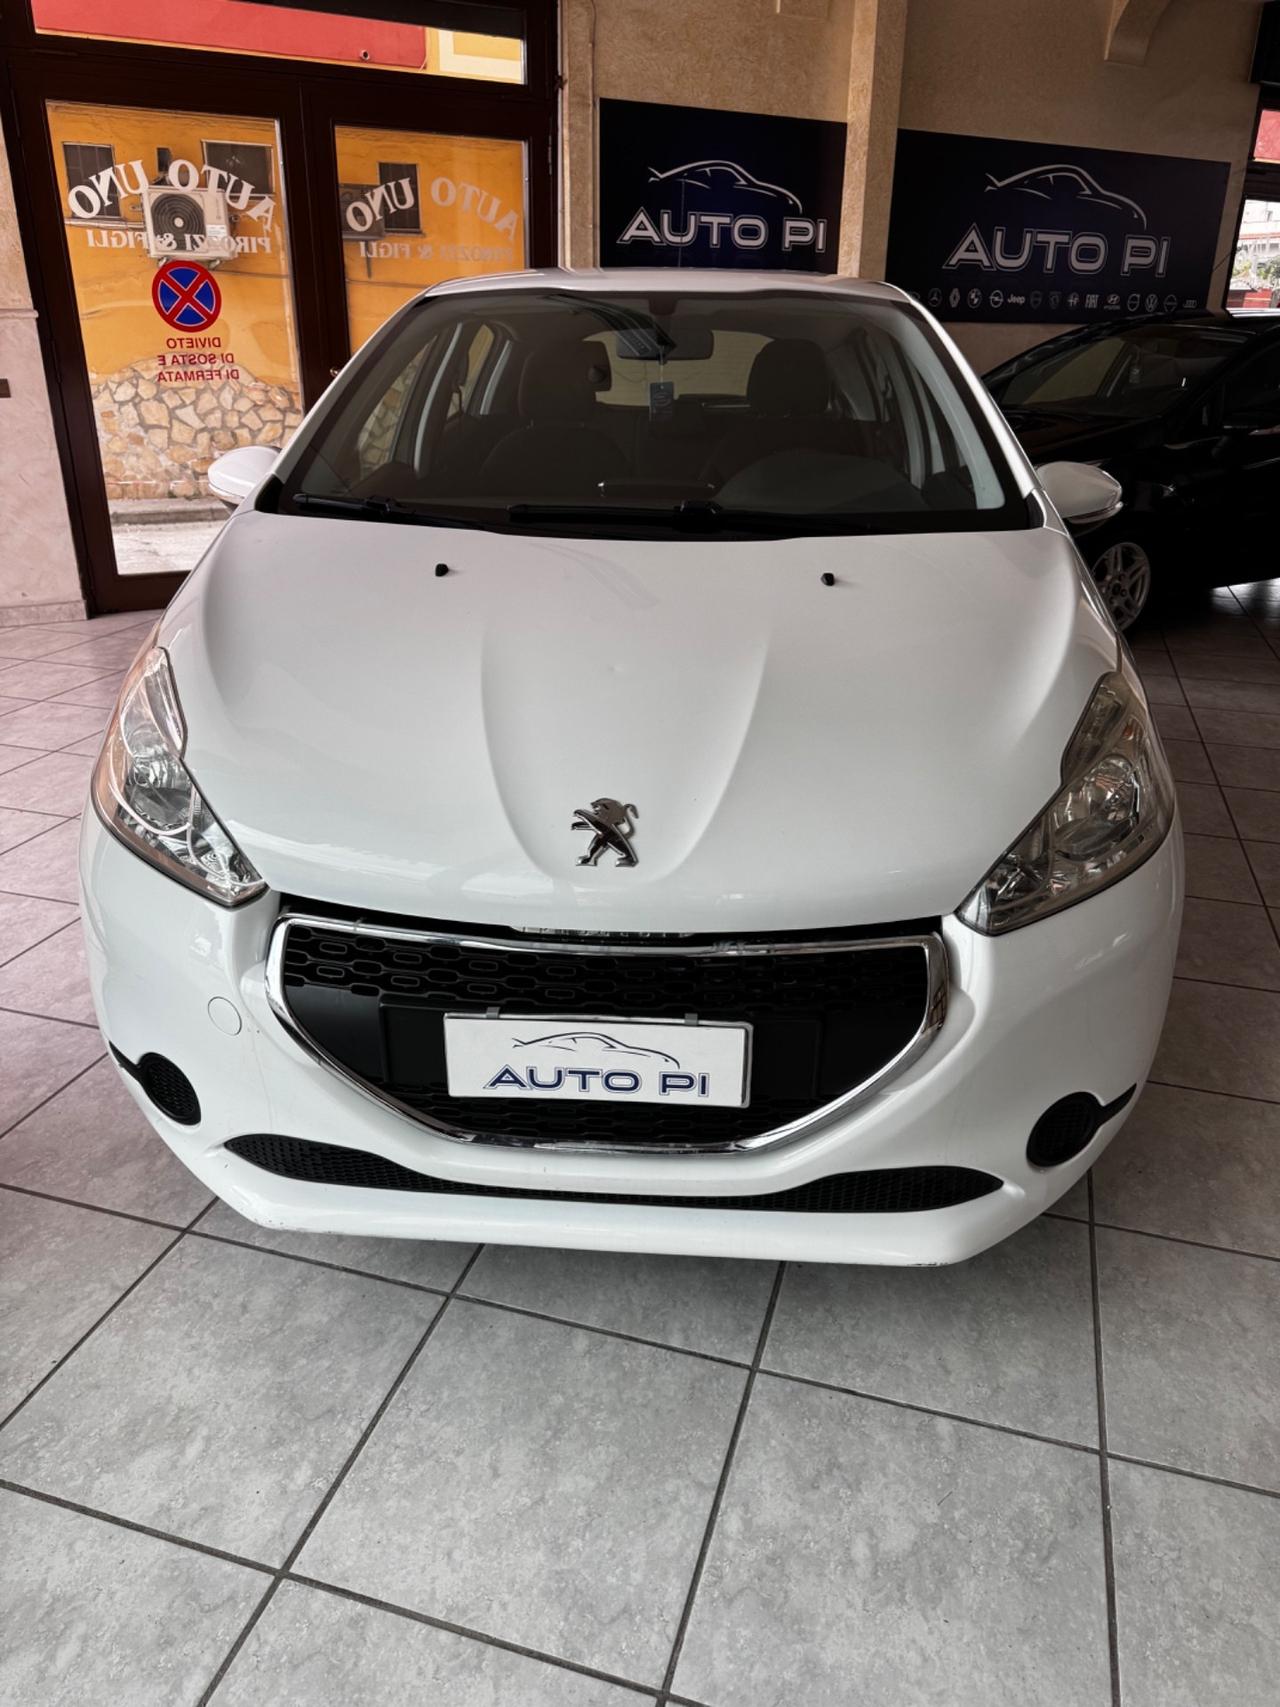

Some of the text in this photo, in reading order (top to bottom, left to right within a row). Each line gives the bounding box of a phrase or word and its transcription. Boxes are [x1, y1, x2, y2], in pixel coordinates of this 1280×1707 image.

[616, 206, 828, 253] AUTO PI
[942, 222, 1171, 278] AUTO PI
[483, 1064, 709, 1098] AUTO PI
